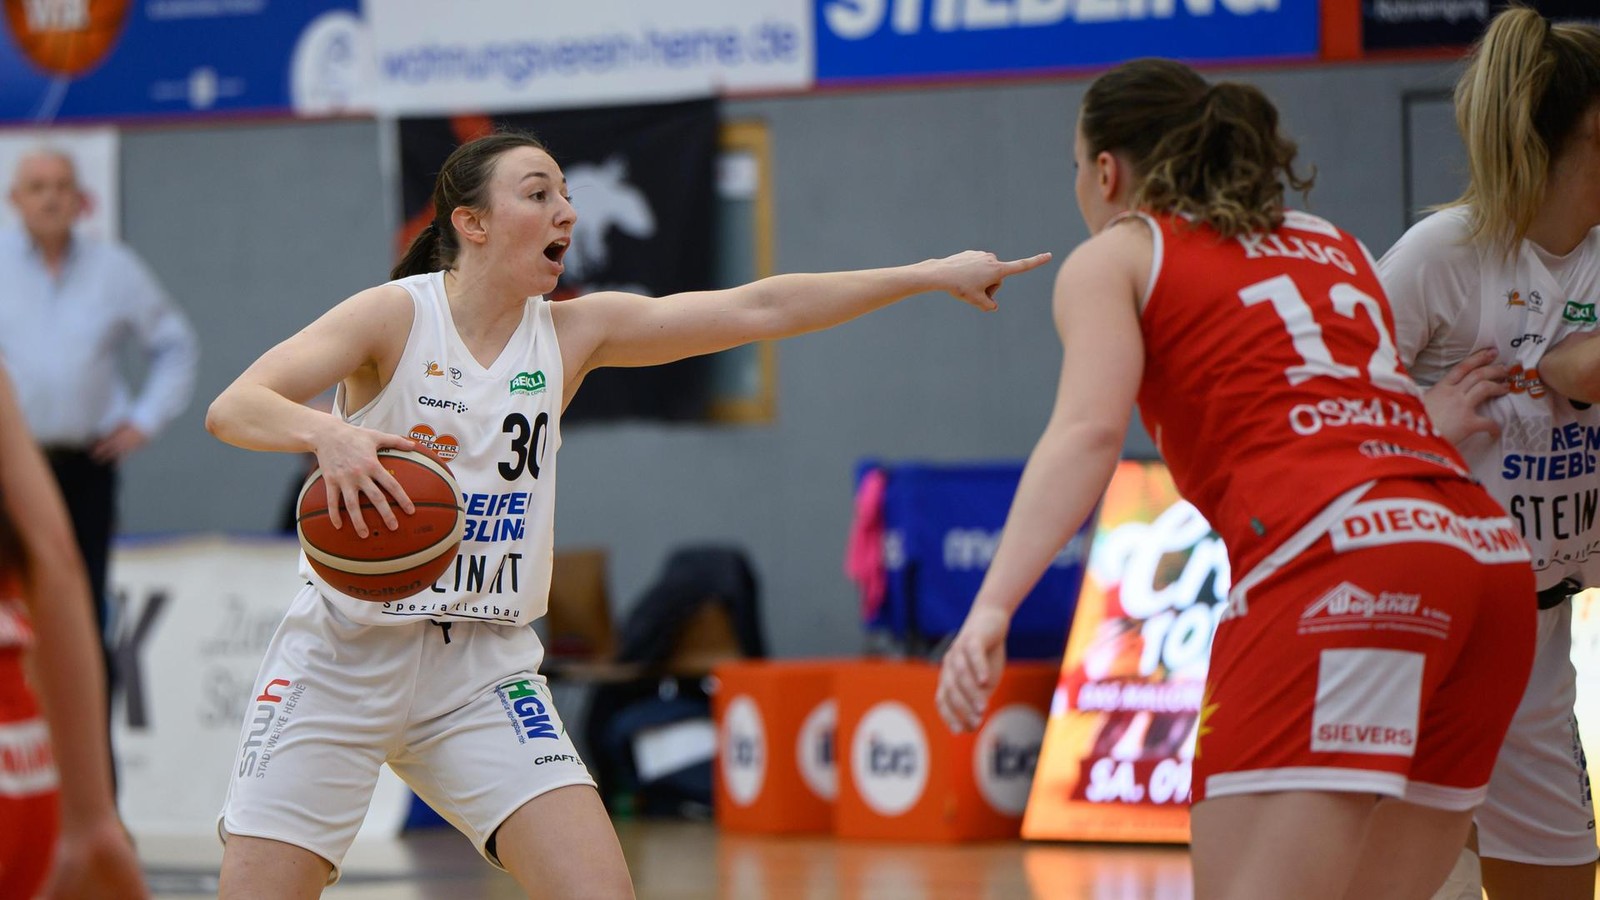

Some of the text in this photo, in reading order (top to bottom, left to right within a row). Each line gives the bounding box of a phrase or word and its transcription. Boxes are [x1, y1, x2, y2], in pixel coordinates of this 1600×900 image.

[1236, 234, 1357, 276] KLUG
[1238, 273, 1424, 397] 12
[418, 395, 457, 411] CRAFT
[411, 432, 433, 441] CITY
[497, 412, 549, 481] 30
[462, 492, 533, 516] EIFE
[347, 579, 422, 598] molten
[501, 680, 559, 740] HGW
[256, 683, 306, 779] STADTWERKE HERNE
[1316, 724, 1413, 745] SIEVERS
[534, 754, 575, 765] CRAFT
